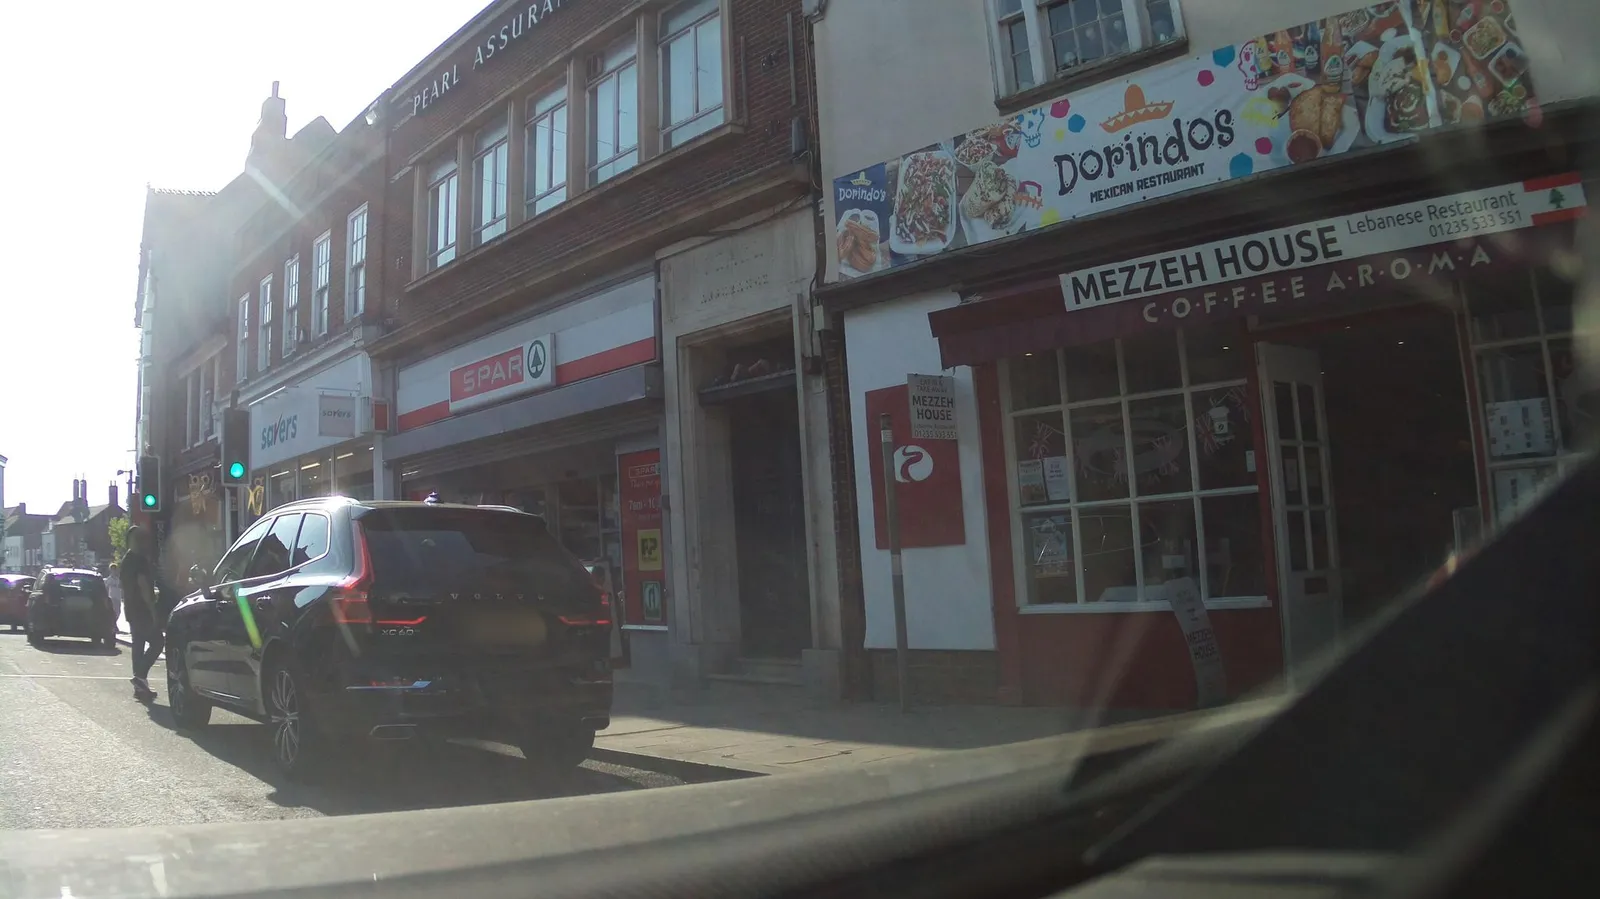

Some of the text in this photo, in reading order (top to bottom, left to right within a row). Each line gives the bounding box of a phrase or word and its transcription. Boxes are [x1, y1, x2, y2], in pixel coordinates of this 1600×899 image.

[413, 0, 562, 116] PEARL ASSURA
[1090, 163, 1205, 203] MEXICAN RESTAURANT
[1347, 190, 1518, 235] Lebanese Restaurant
[1429, 209, 1522, 238] 01235 533 551
[1071, 225, 1343, 305] MEZZEH HOUSE
[463, 355, 522, 393] SPAR
[322, 409, 352, 418] savers
[912, 395, 954, 408] MEZZEH
[917, 409, 952, 421] HOUSE
[261, 414, 298, 450] savers
[449, 592, 545, 600] VOLVO
